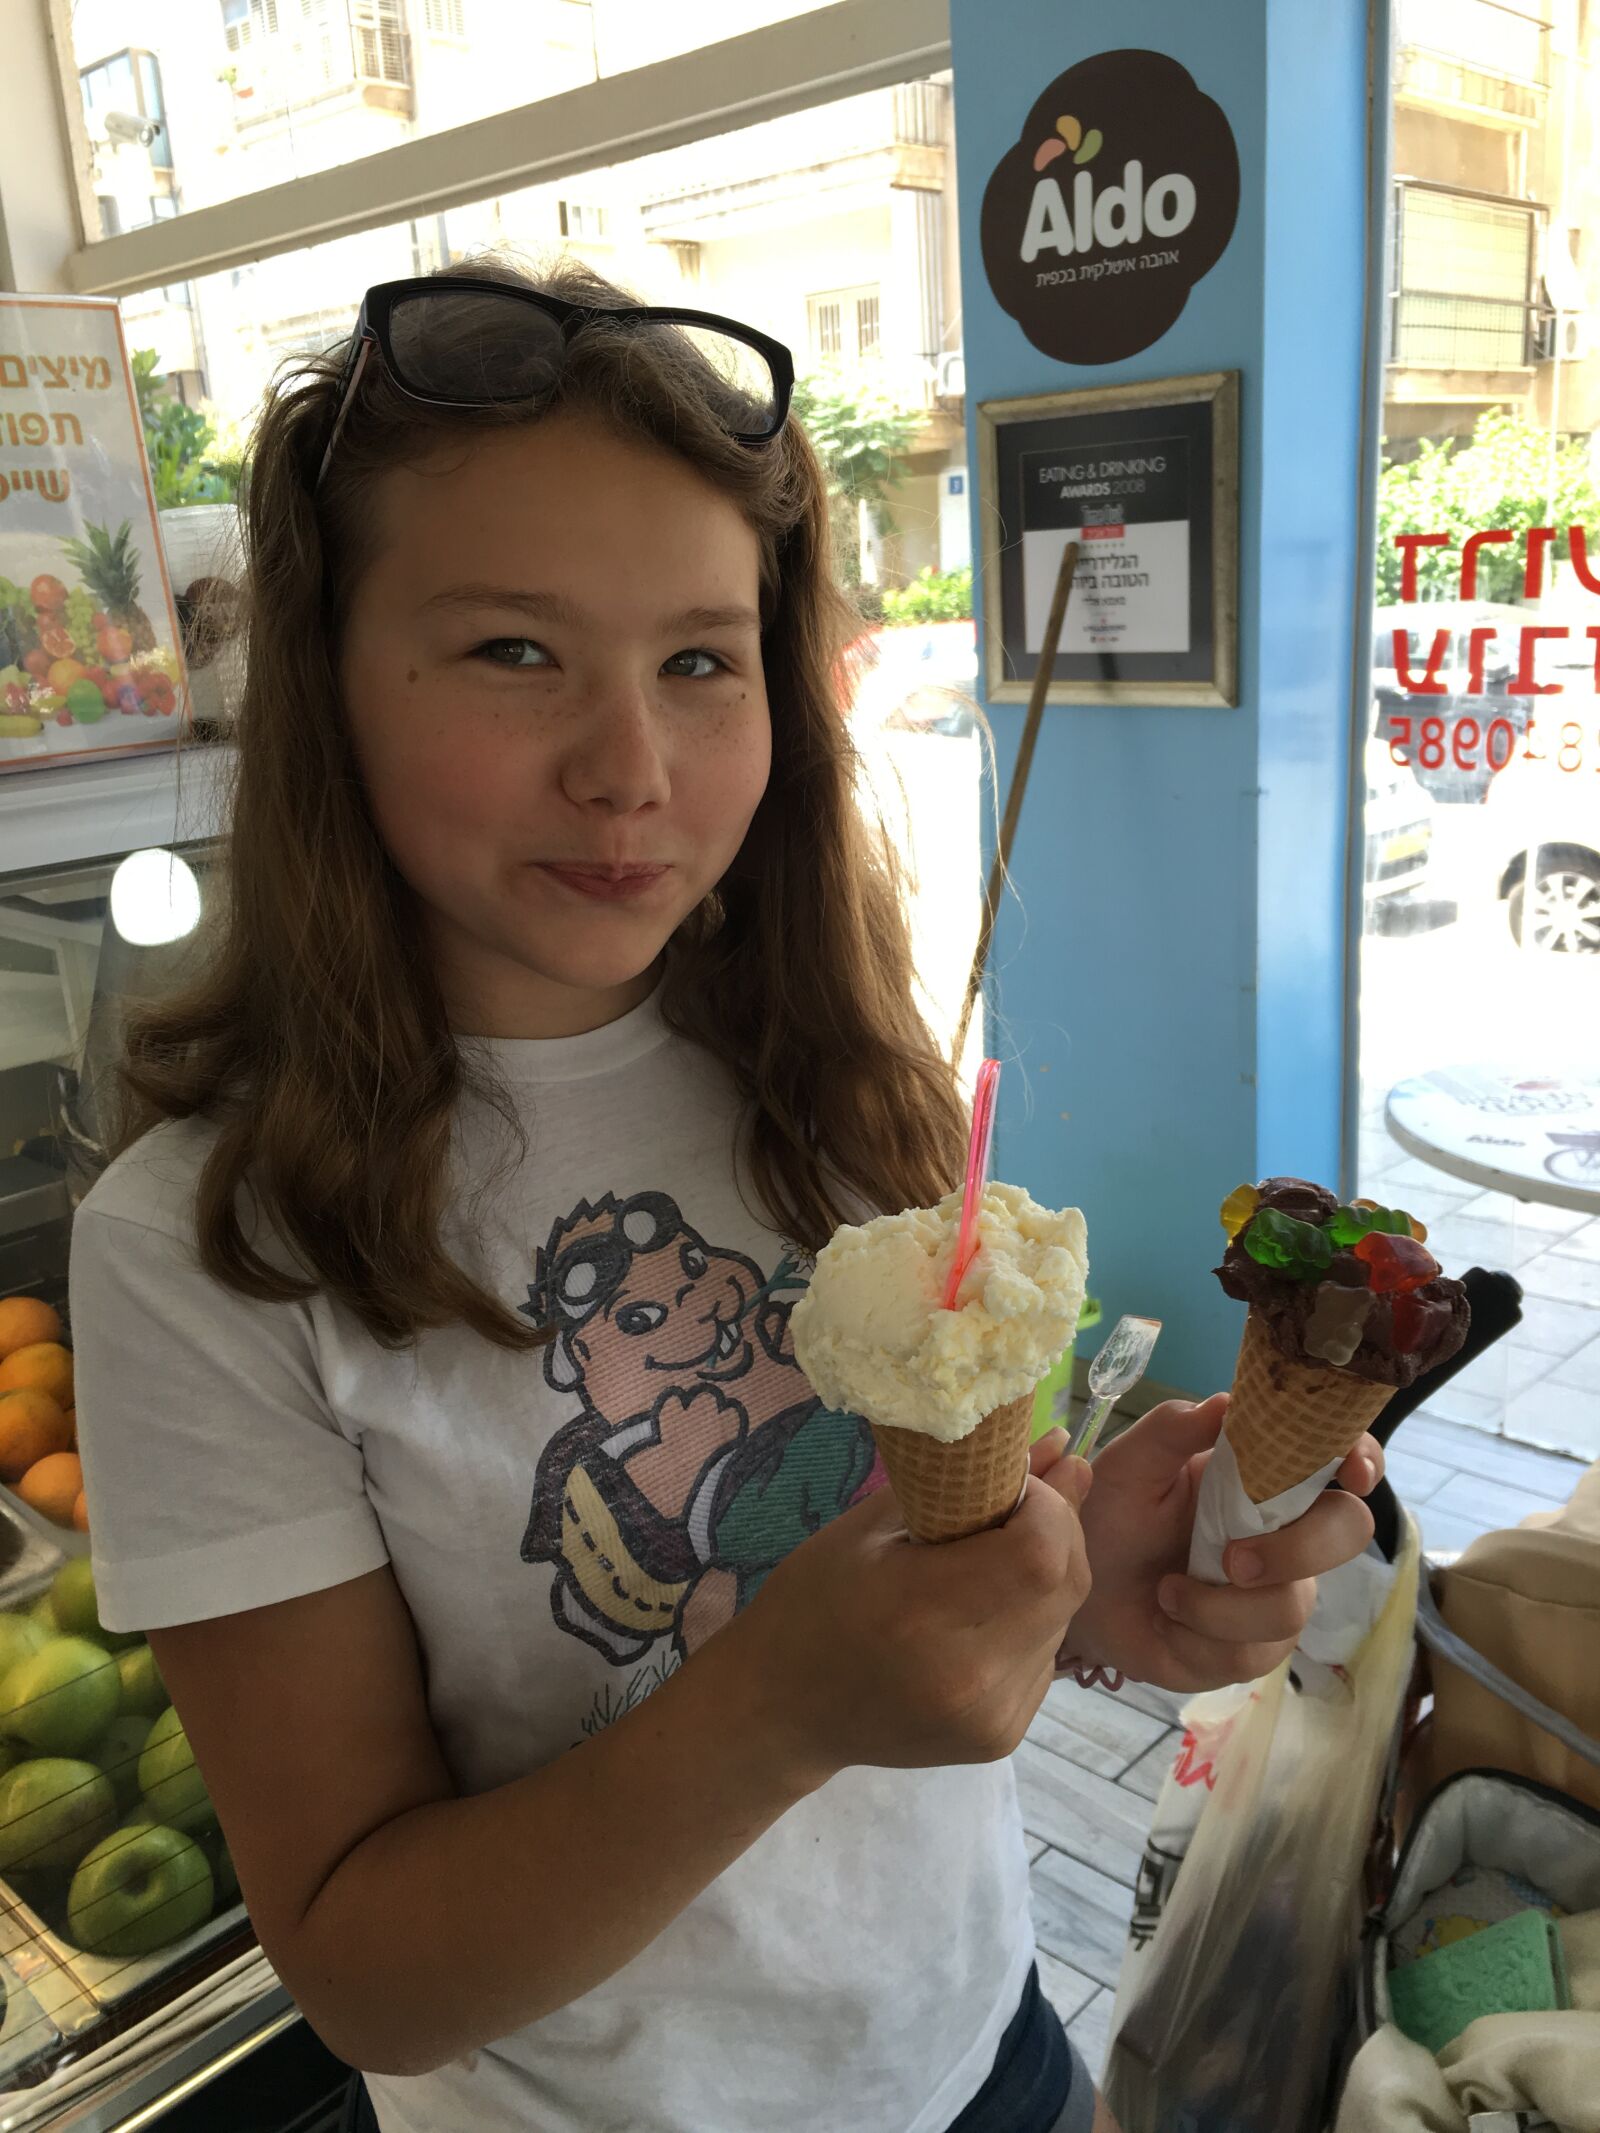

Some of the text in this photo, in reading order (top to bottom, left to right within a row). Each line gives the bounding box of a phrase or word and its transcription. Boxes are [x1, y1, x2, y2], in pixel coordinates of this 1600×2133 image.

[1020, 159, 1197, 263] Aldo
[1139, 249, 1180, 270] אהבה
[1035, 268, 1078, 288] בכפית
[0, 353, 113, 390] מיצים
[0, 411, 84, 447] תפו
[1039, 456, 1167, 483] EATING & DRINKING
[1060, 479, 1146, 499] AWARDS 2008
[1101, 572, 1149, 589] הטובה
